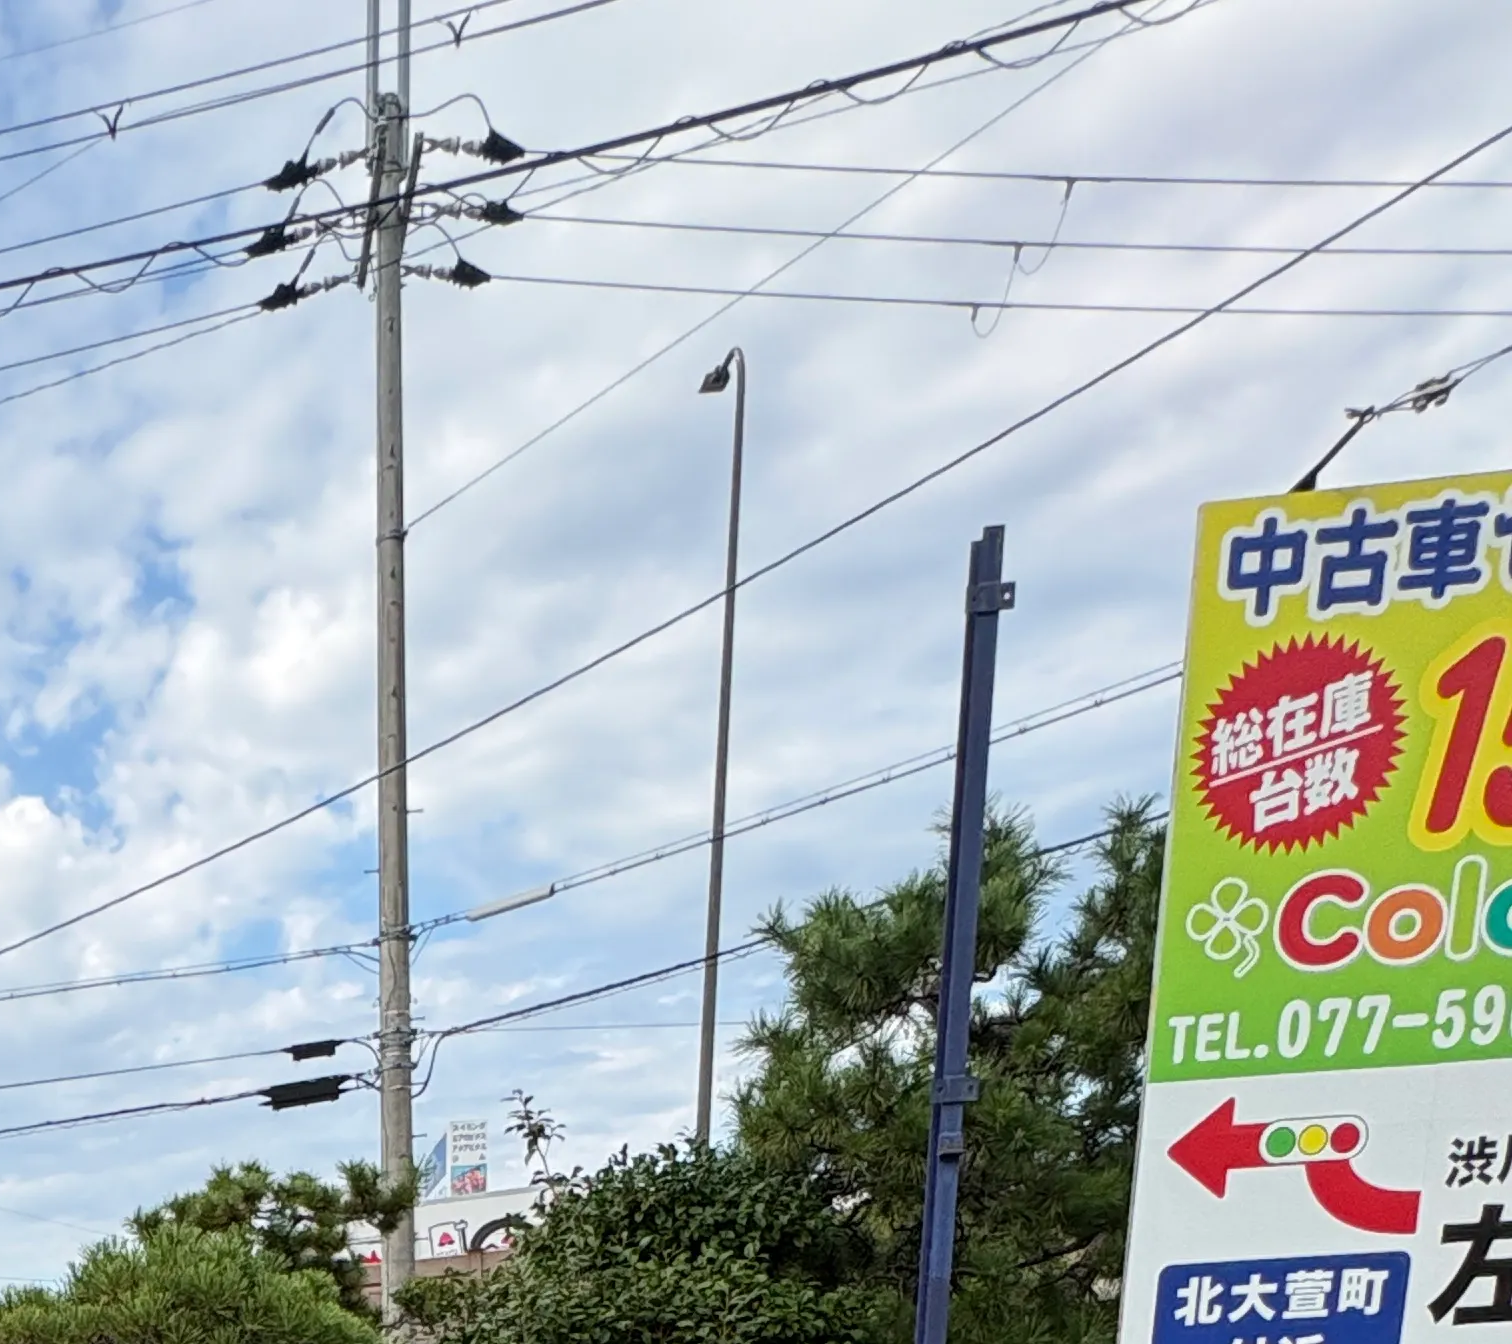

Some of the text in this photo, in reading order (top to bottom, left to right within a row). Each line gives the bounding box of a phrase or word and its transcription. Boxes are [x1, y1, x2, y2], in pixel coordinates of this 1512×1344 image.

[1225, 496, 1512, 618] 中古車
[1210, 670, 1375, 776] 総在庫
[1249, 746, 1361, 833] 台数
[1445, 1134, 1512, 1188] 渋
[1173, 1267, 1390, 1328] 北大萱町
